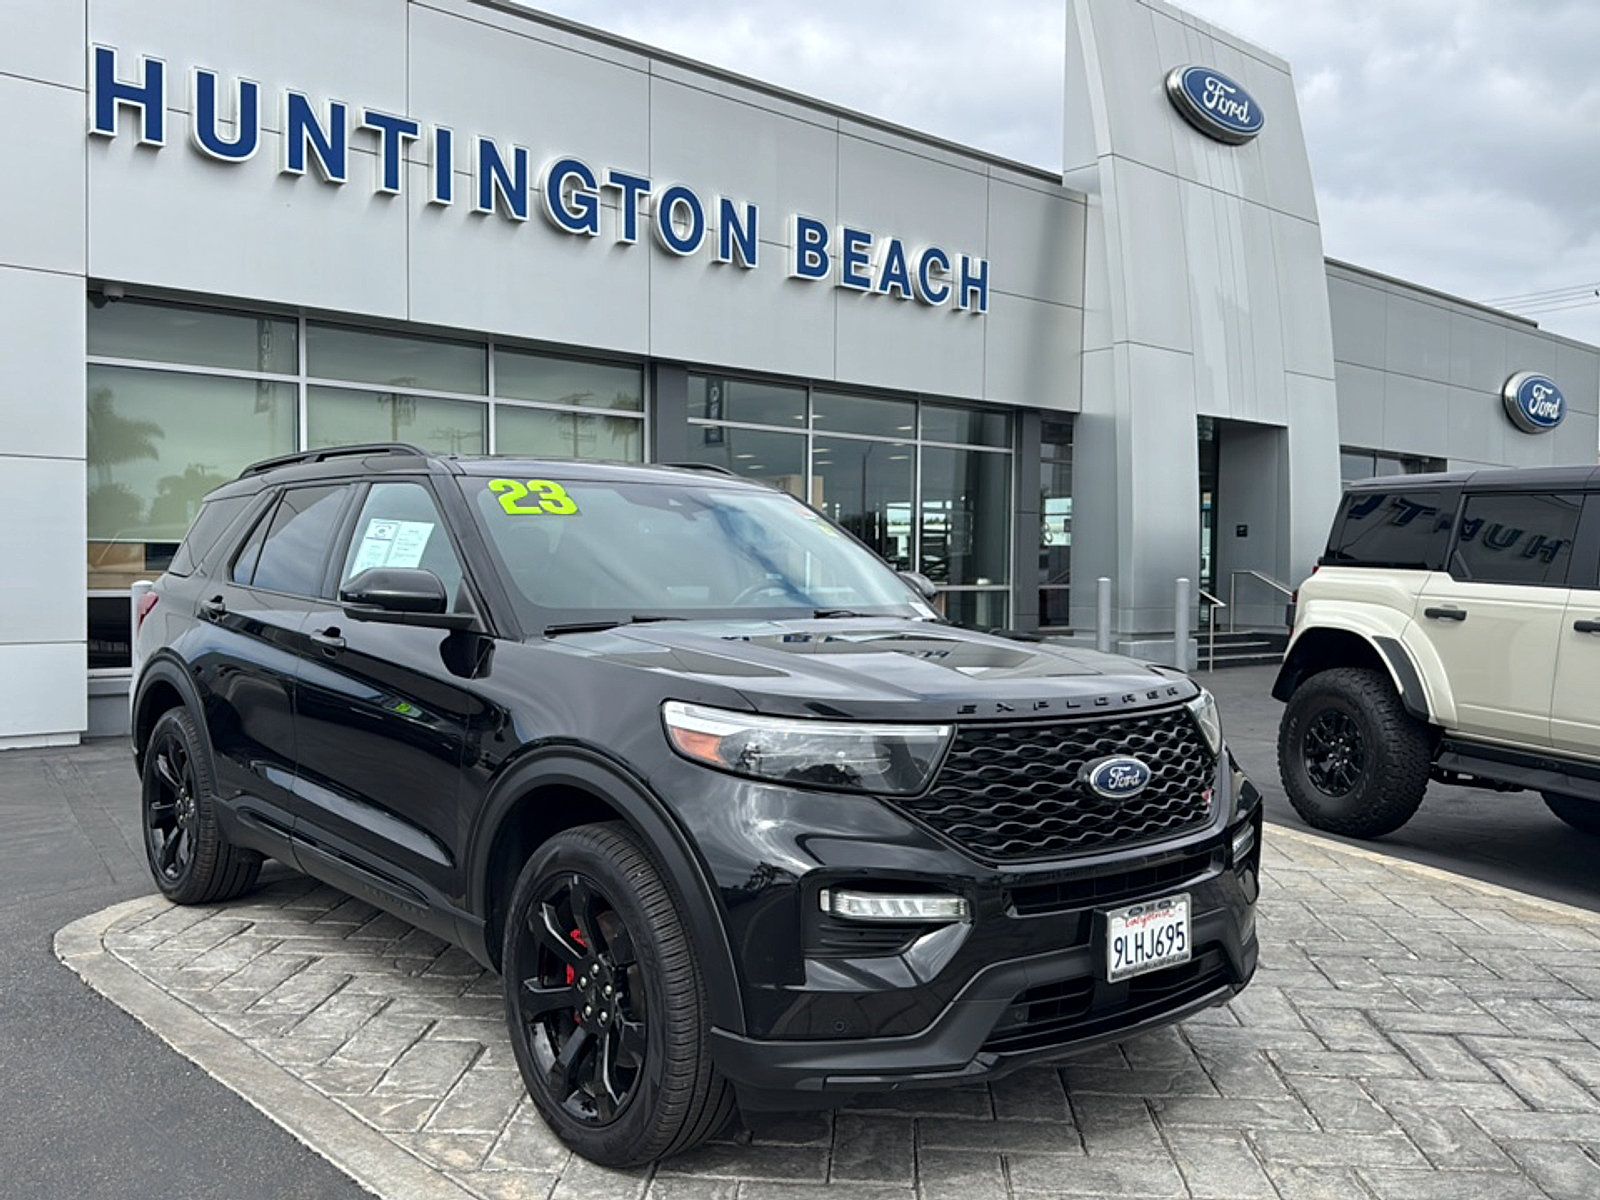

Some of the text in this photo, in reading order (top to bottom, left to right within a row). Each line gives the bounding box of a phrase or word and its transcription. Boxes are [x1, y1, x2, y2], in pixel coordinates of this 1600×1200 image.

[1203, 76, 1250, 124] Ford
[89, 43, 990, 313] HUNTINGTON BEACH
[1528, 383, 1561, 419] Ford
[488, 479, 578, 515] 23
[956, 686, 1179, 715] EXPLORER
[1107, 765, 1142, 790] Ford
[1113, 920, 1186, 970] 9LHJ695
